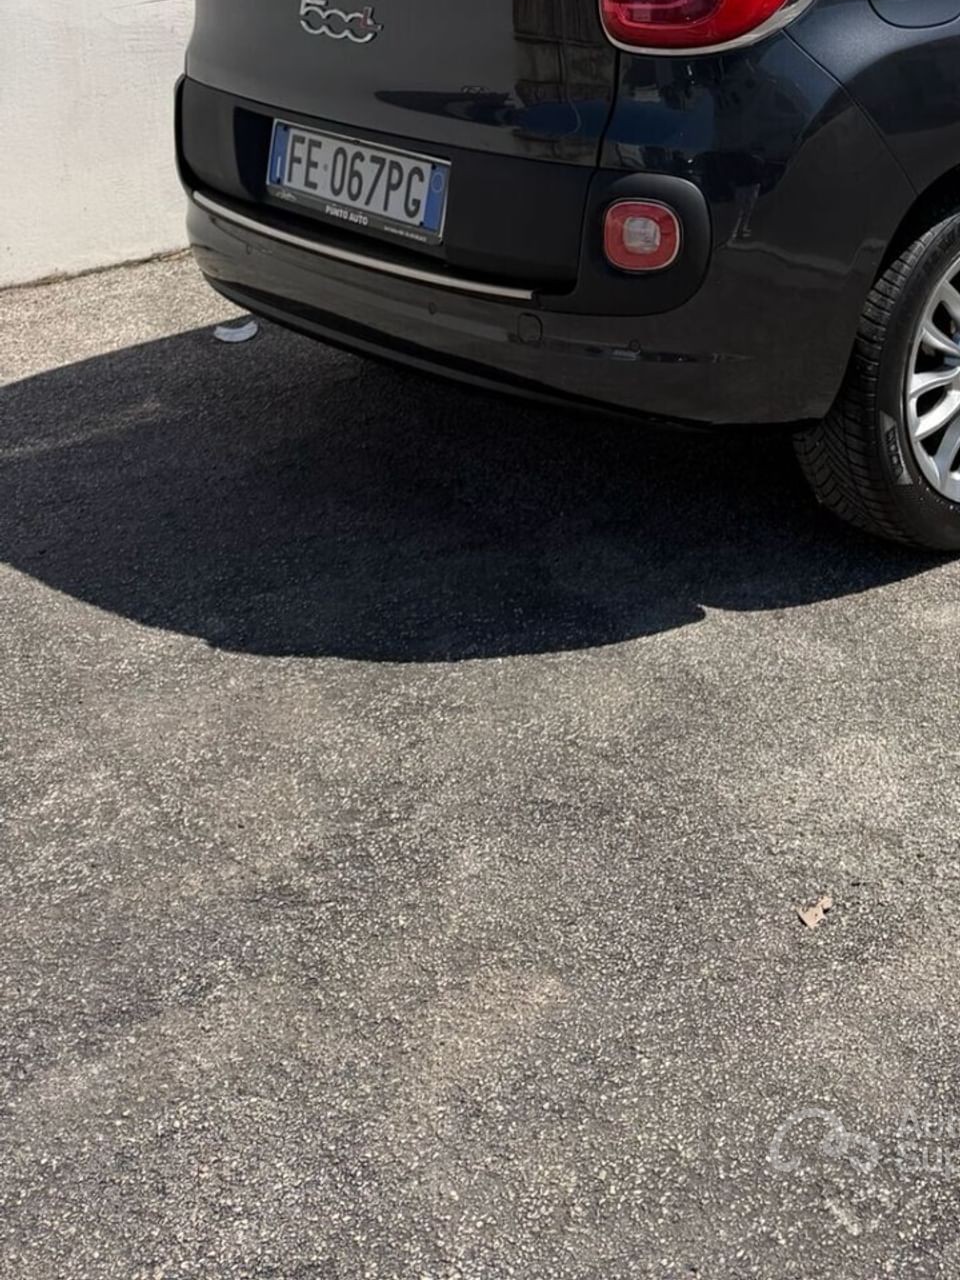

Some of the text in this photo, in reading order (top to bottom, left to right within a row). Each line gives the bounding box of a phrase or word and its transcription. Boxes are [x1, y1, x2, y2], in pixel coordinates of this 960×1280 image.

[287, 134, 425, 219] FE 067PG
[348, 211, 369, 226] AUTO
